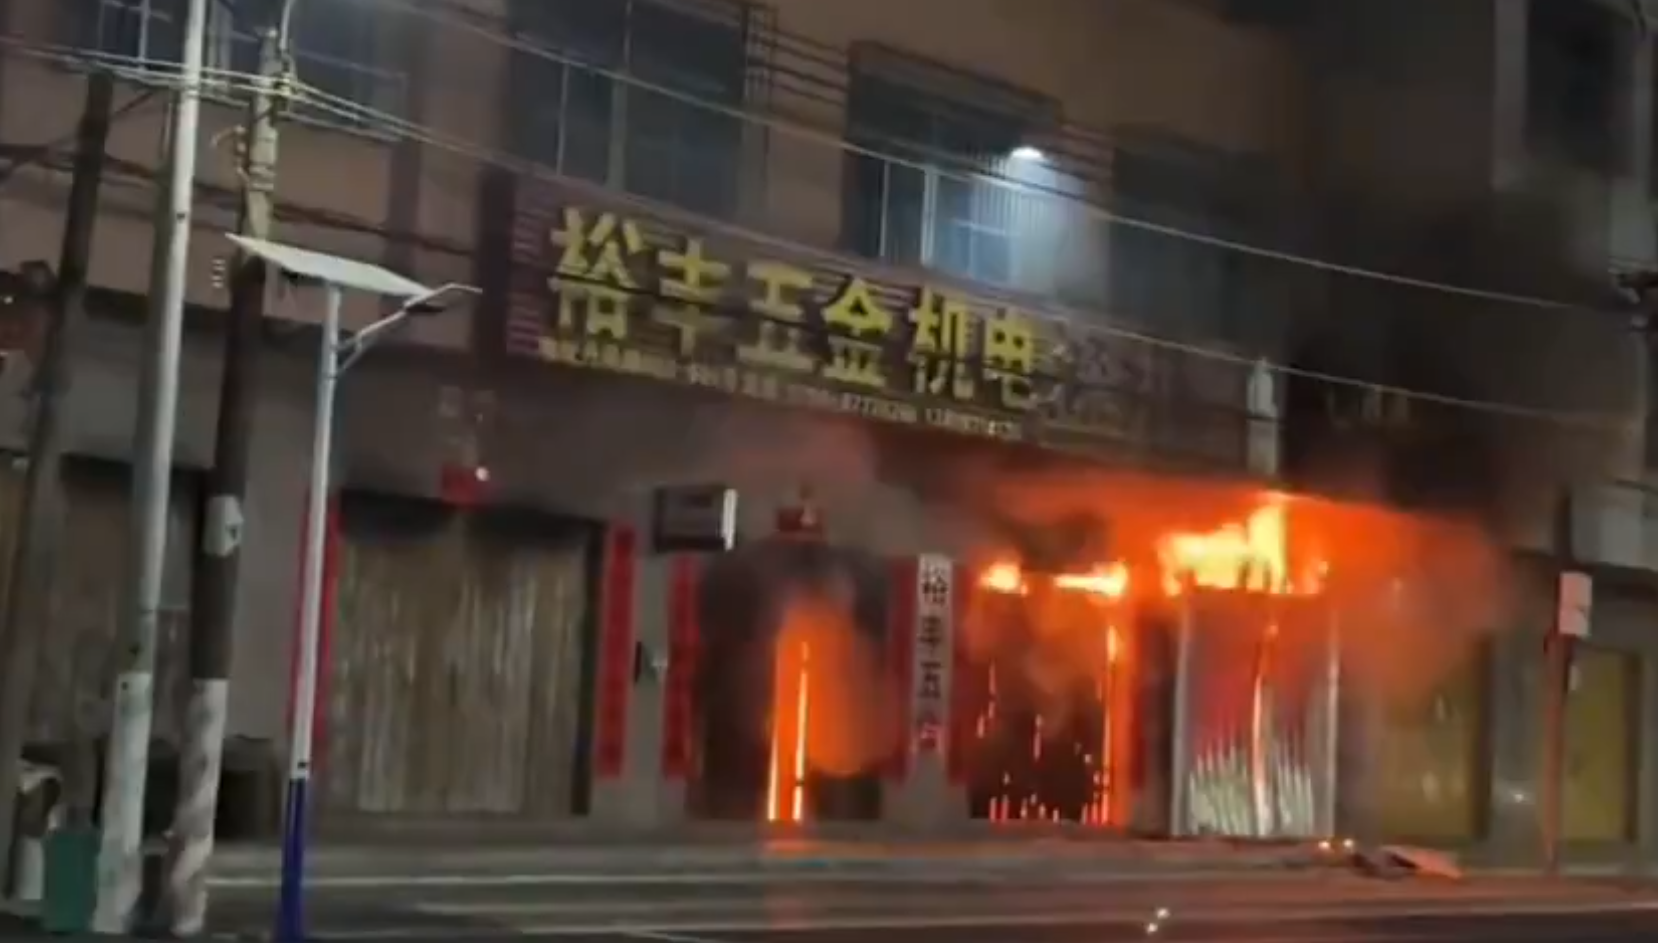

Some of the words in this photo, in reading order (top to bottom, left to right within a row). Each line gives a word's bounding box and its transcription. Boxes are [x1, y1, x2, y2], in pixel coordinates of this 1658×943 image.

[549, 206, 1037, 409] 裕丰五金机电
